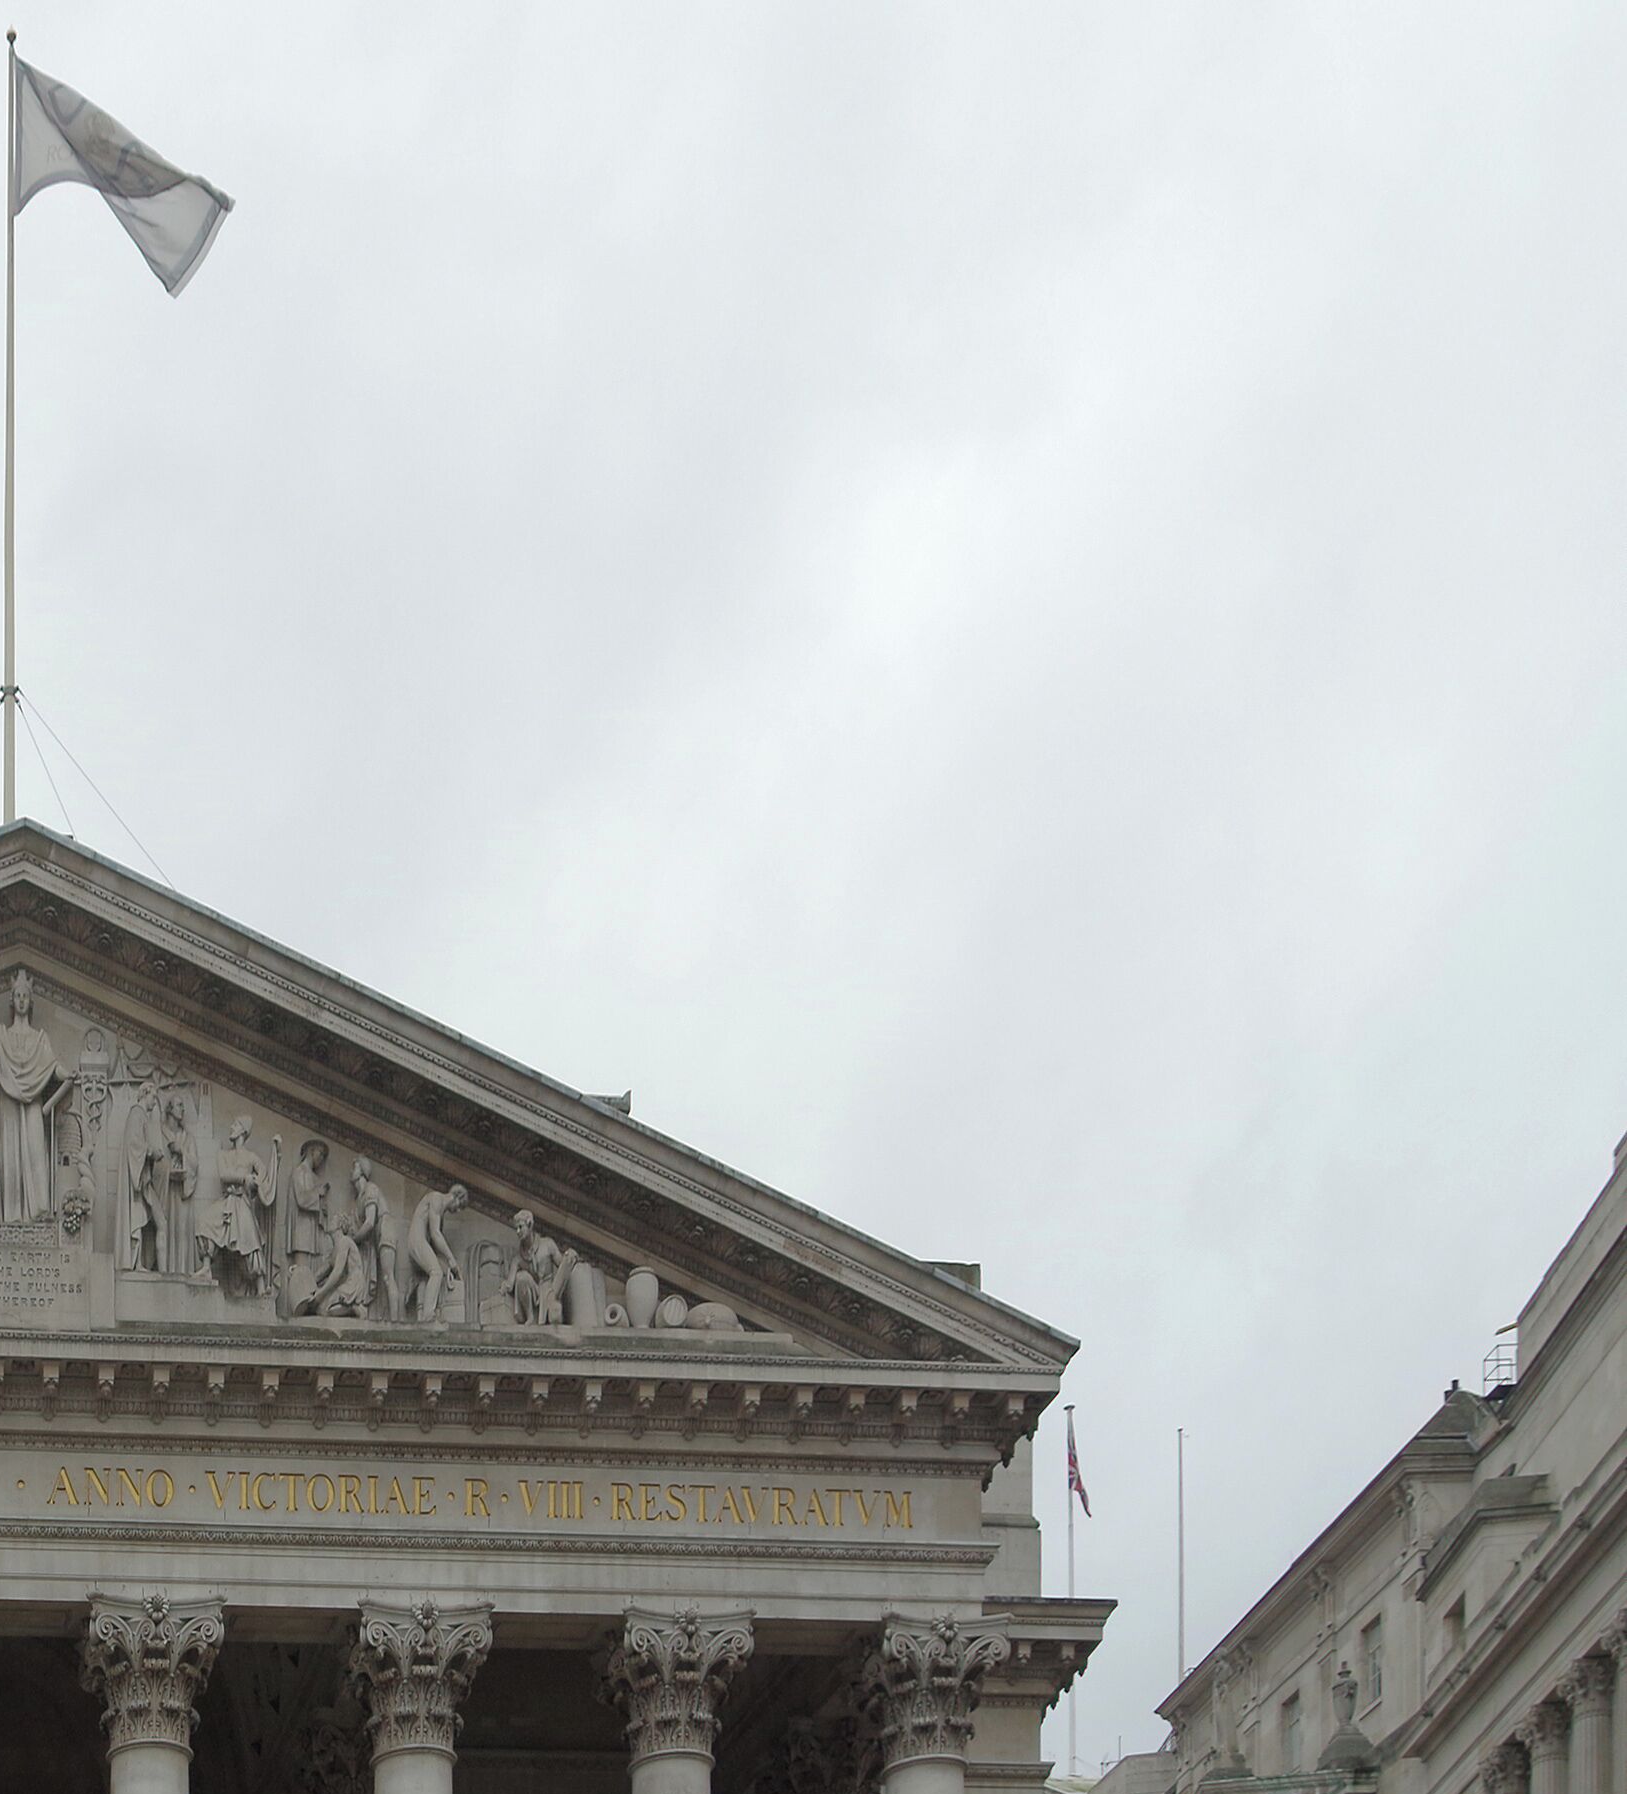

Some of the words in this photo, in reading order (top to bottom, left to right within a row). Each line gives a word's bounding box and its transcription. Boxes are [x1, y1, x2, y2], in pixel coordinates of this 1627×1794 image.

[10, 1251, 51, 1264] EARTH
[59, 1253, 70, 1264] IS
[20, 1267, 60, 1278] LORD'S
[27, 1282, 82, 1294] FULNESS
[46, 1466, 174, 1508] ANNO
[204, 1471, 437, 1515] VICTORIAE
[463, 1477, 491, 1517] R
[517, 1479, 584, 1519] VIII
[610, 1482, 913, 1529] RESTAVRATVM
